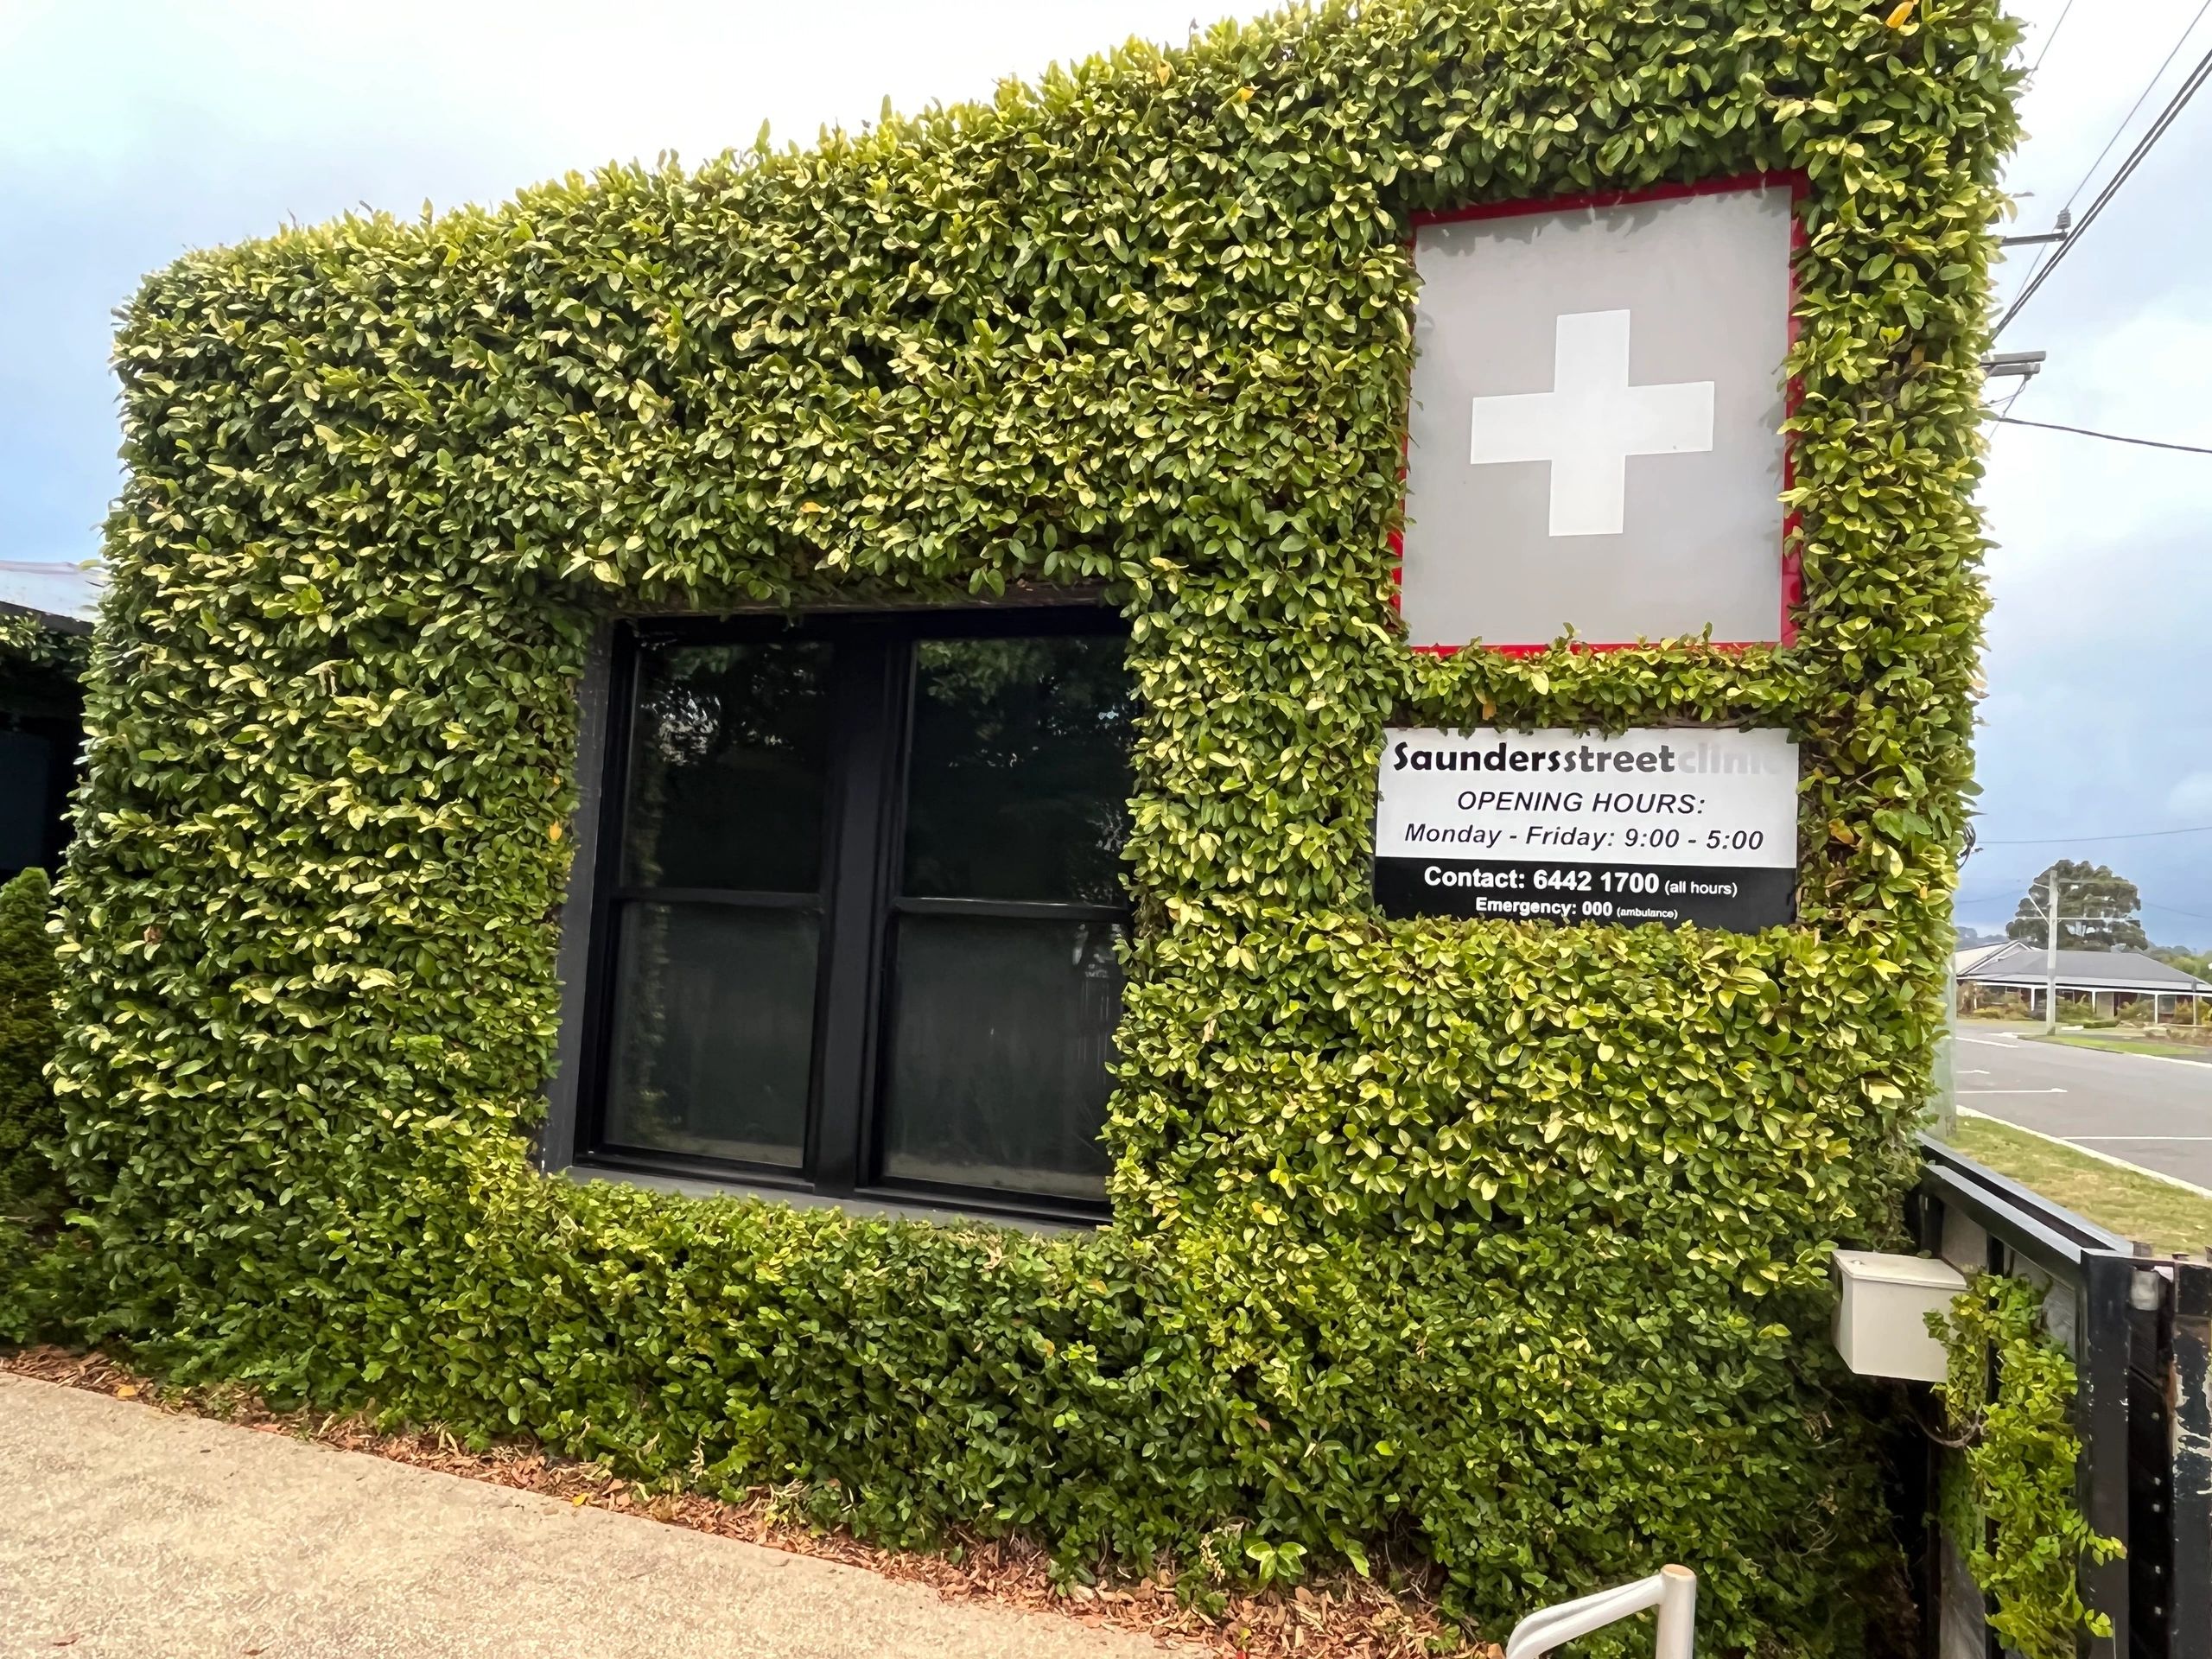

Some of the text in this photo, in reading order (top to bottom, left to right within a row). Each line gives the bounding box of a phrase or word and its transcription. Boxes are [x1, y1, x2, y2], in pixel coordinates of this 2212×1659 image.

[1458, 791, 1706, 814] OPENING HOURS:
[1404, 823, 1503, 849] Monday
[1525, 825, 1616, 851] Friday:
[1624, 828, 1680, 849] 9:00
[1706, 830, 1764, 850] 5:00
[1424, 866, 1738, 899] Contact: 6442 1700 (all hours)
[1475, 896, 1679, 920] Emergency: 000 (ambulance)
